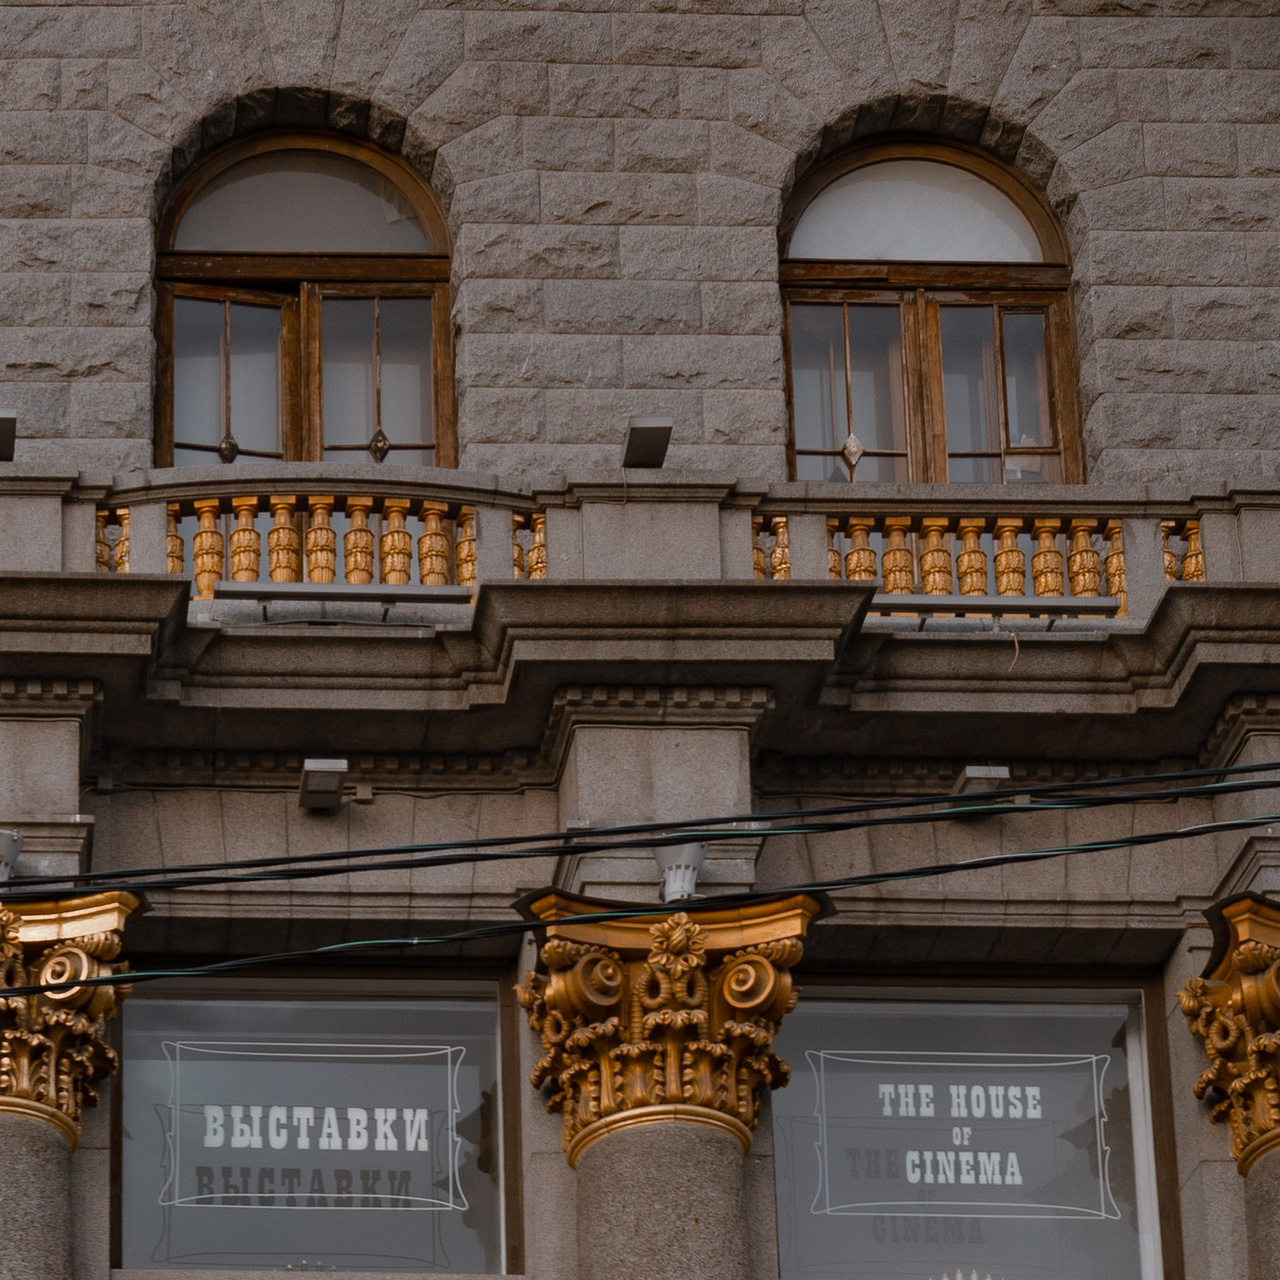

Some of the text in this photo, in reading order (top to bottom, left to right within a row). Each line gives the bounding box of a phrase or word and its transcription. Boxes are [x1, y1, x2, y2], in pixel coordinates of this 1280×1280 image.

[878, 1083, 1043, 1119] THE HOUSE
[202, 1104, 430, 1152] ВЫСТАВКИ
[951, 1126, 973, 1146] OF
[905, 1149, 1024, 1186] CINEMA
